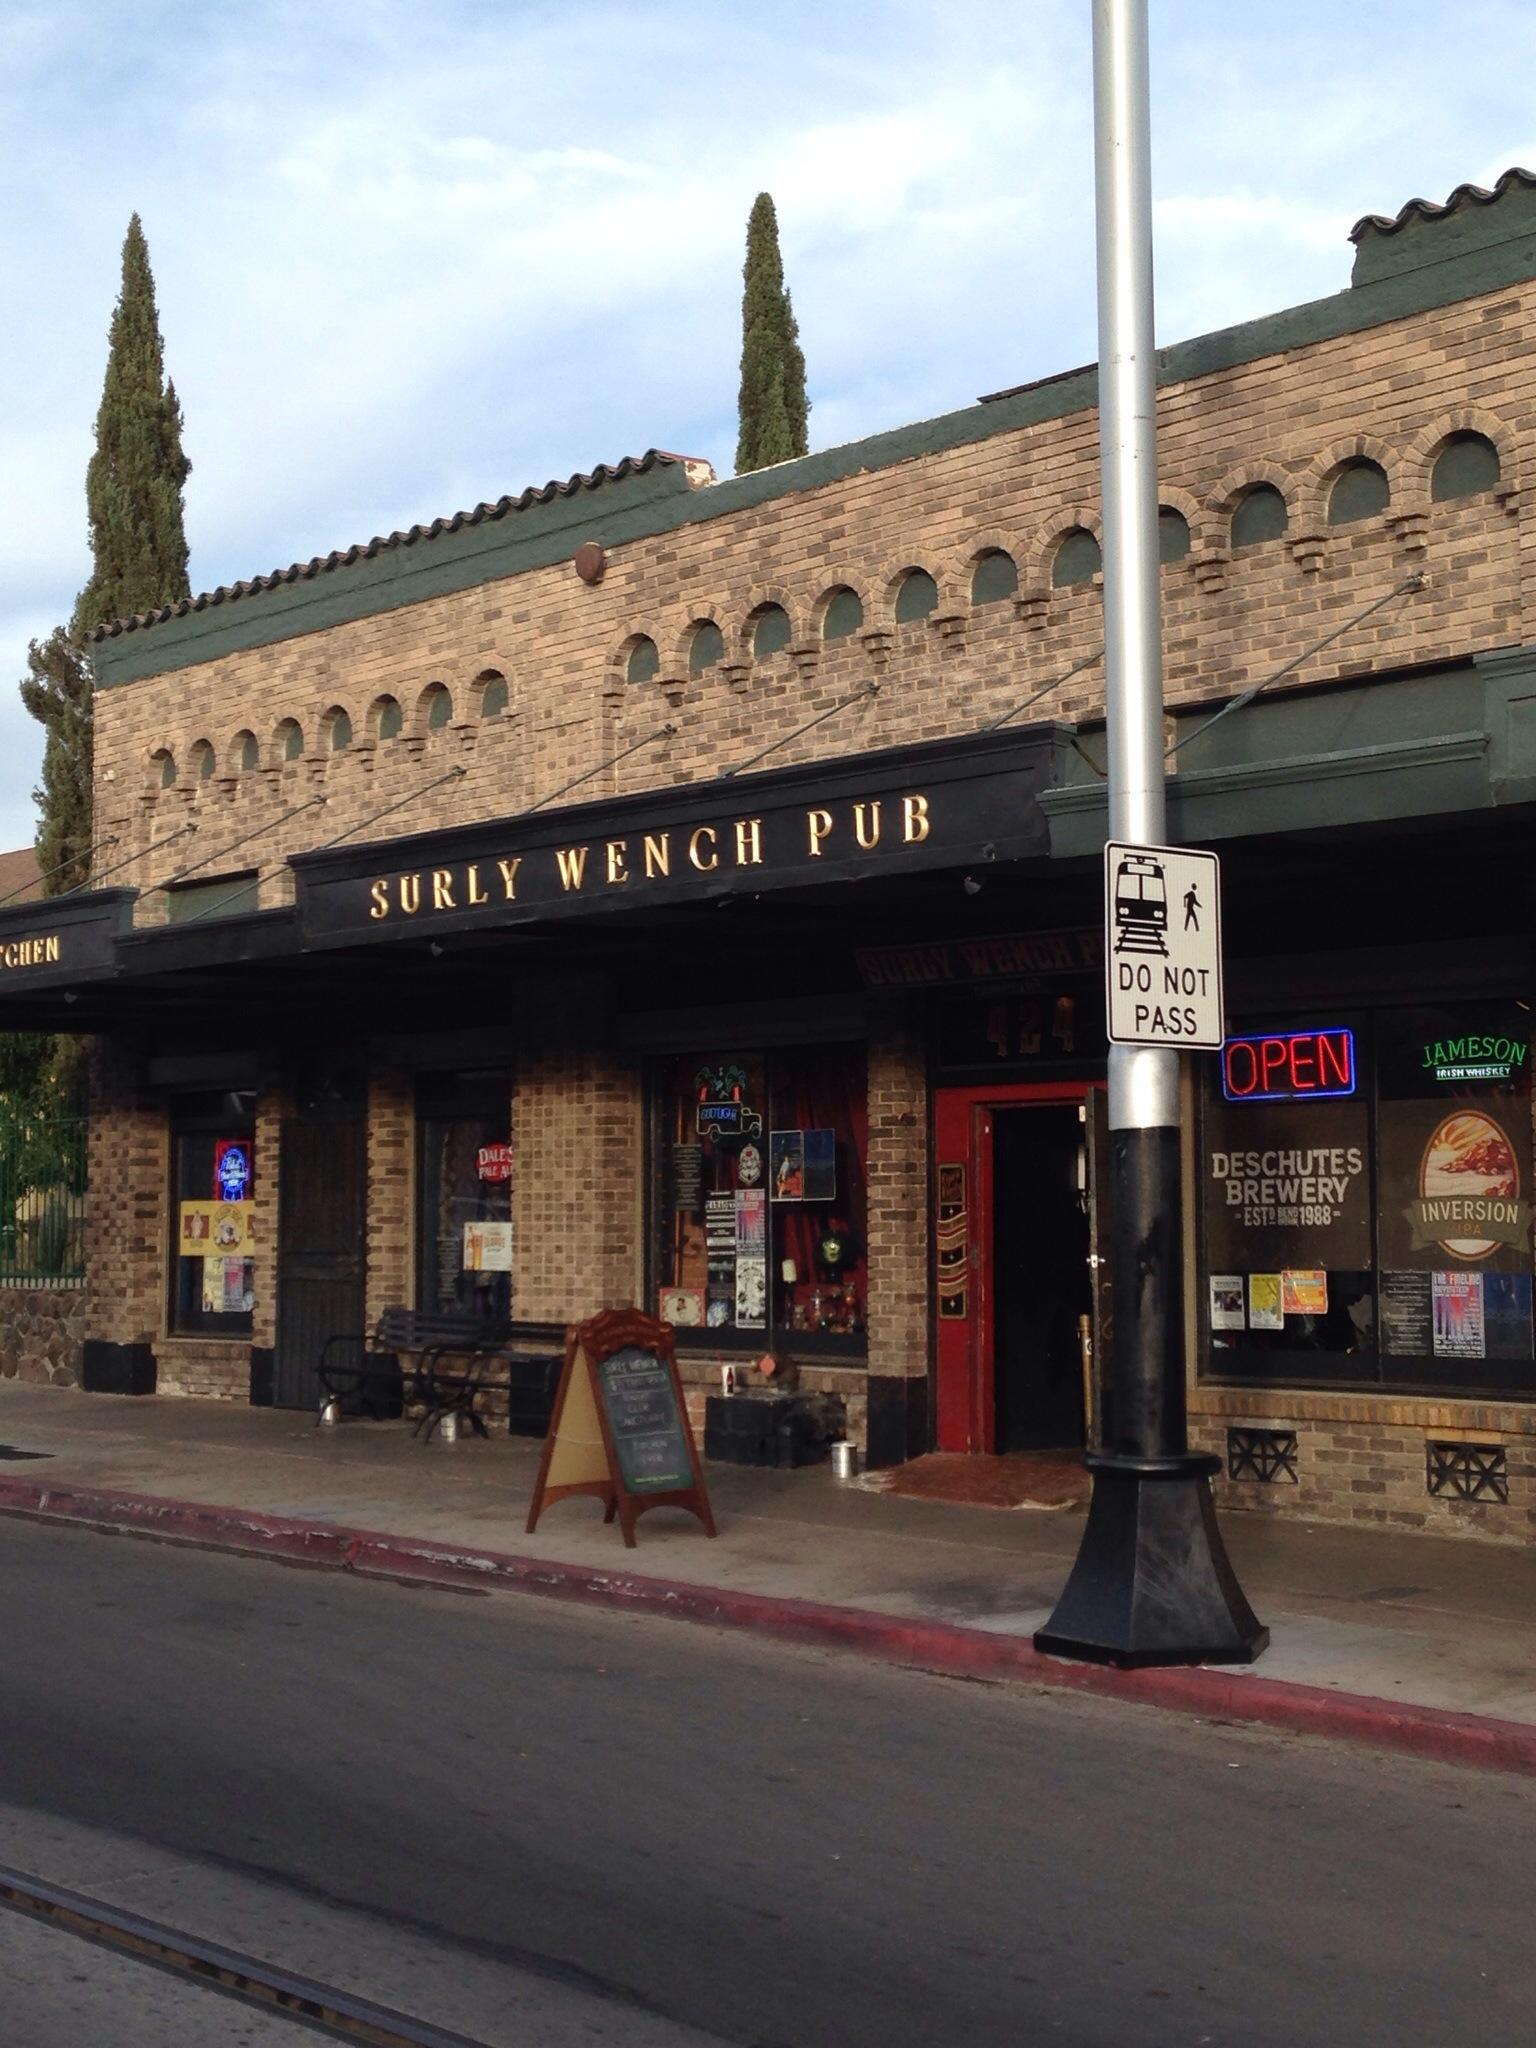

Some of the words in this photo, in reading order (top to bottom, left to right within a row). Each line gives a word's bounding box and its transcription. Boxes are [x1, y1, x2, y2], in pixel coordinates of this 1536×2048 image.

[368, 856, 523, 920] SURLY
[555, 817, 763, 892] WENCH
[806, 793, 931, 857] PUB
[1119, 963, 1152, 992] DO
[1164, 965, 1210, 996] NOT
[1135, 1004, 1197, 1036] PASS
[1226, 1031, 1349, 1096] OPEN
[1422, 1036, 1528, 1068] JAMESON
[1436, 1068, 1465, 1079] IRISH
[1466, 1066, 1512, 1077] WHISKEY
[500, 1164, 513, 1178] AL
[1212, 1147, 1363, 1179] DESCHUTES
[1225, 1176, 1350, 1206] BREWERY
[1299, 1204, 1332, 1227] 1988
[1422, 1200, 1519, 1225] INVERSION
[1456, 1224, 1482, 1236] IPA
